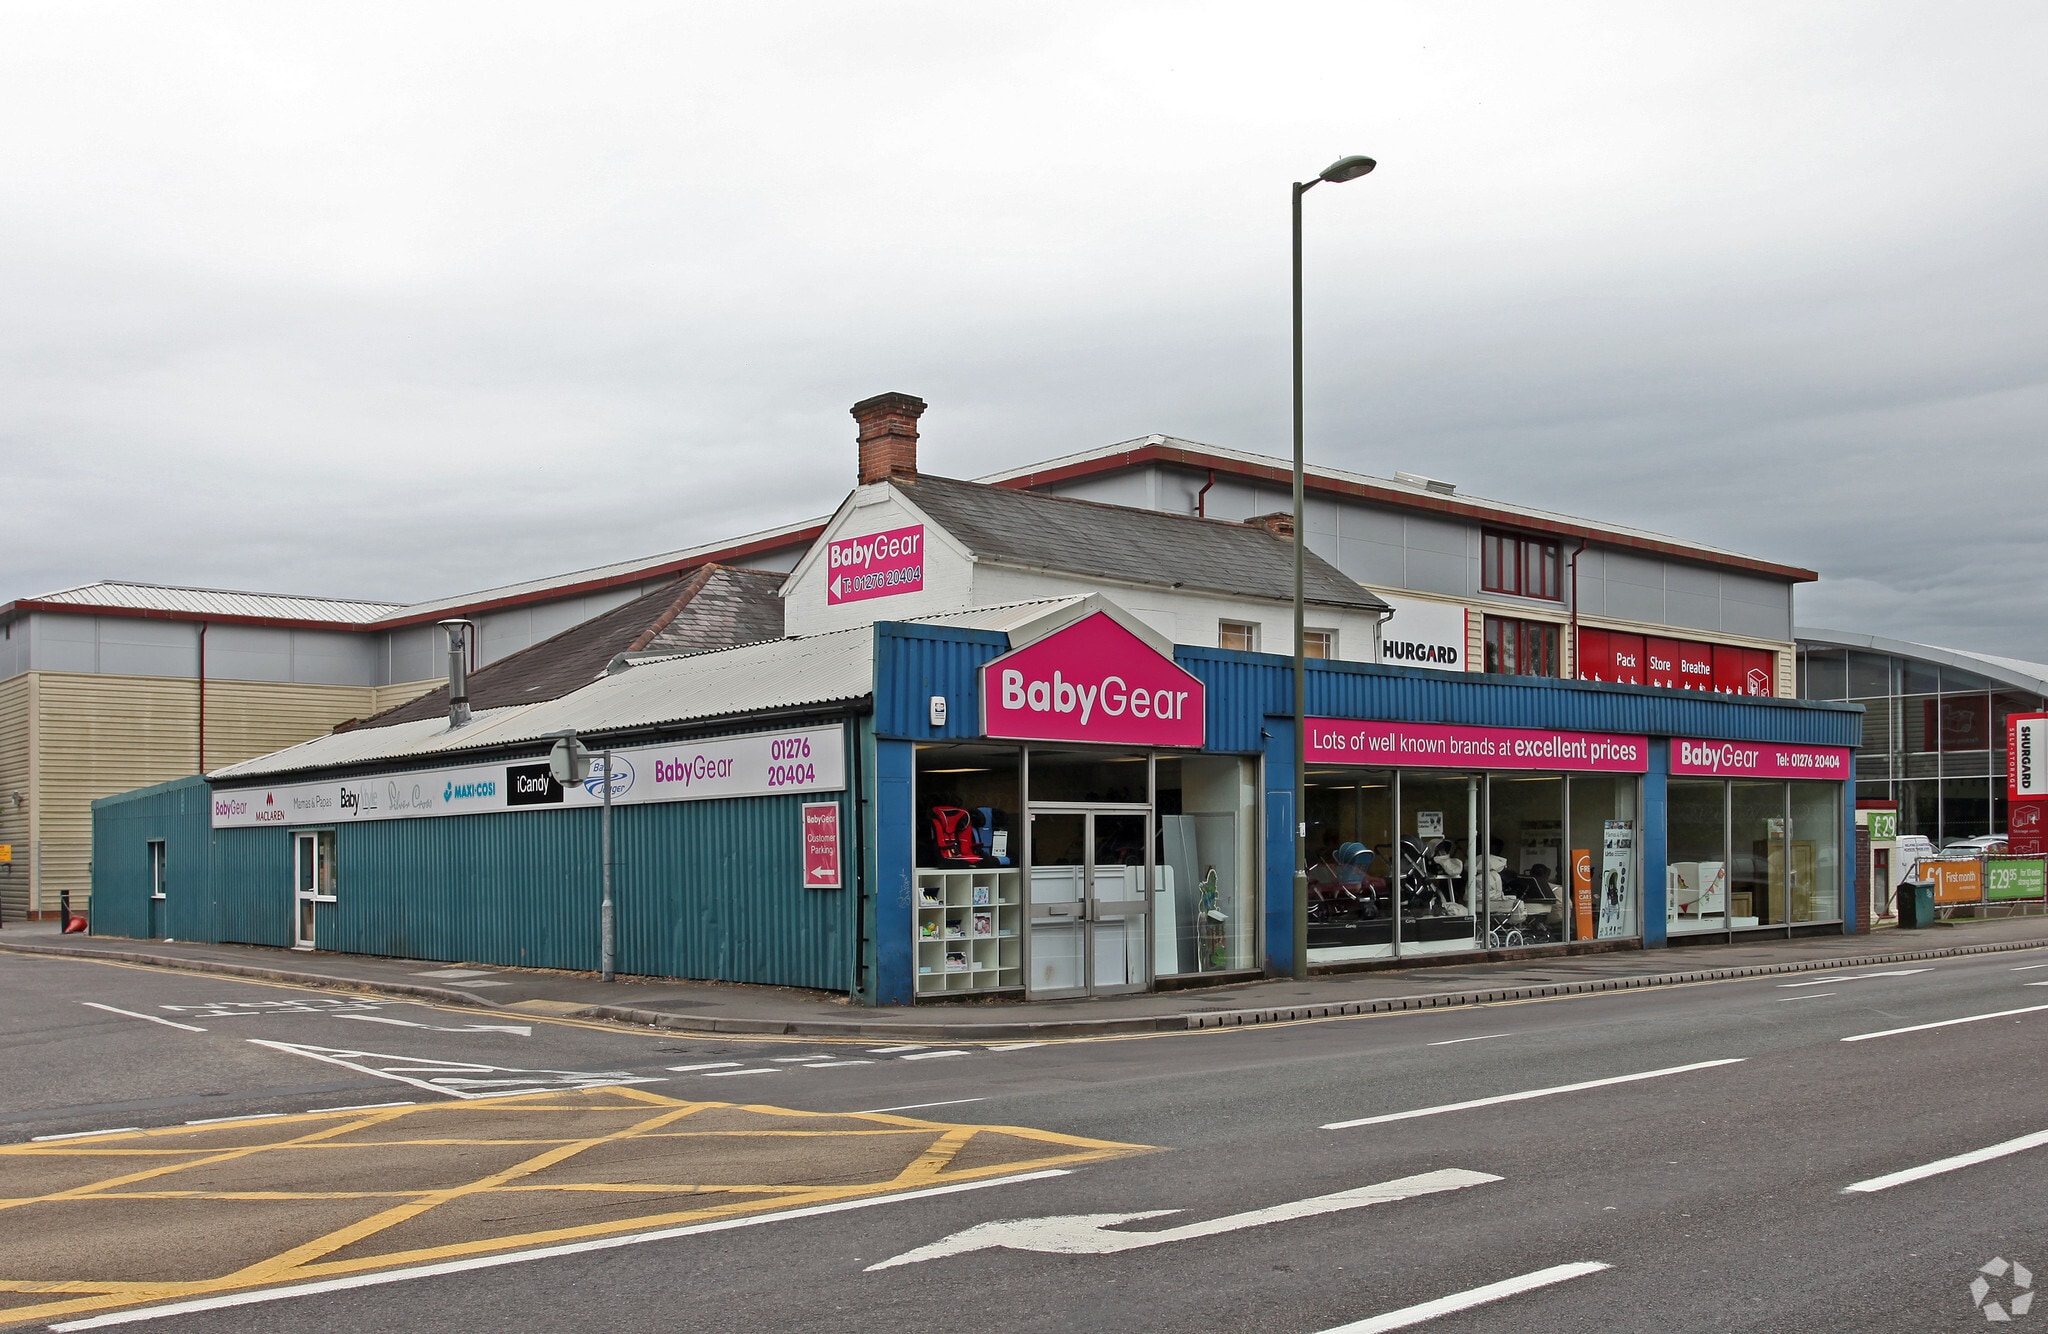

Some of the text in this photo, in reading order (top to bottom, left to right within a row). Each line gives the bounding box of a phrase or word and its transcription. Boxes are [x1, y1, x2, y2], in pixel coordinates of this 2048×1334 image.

[830, 534, 920, 569] BabyGear
[854, 574, 884, 592] 01276
[886, 565, 920, 587] 20404
[1616, 652, 1710, 675] Pack Store Breathe
[1002, 669, 1188, 726] BabyGear
[771, 737, 811, 760] 01276
[1313, 729, 1636, 764] Lots of well known brands at excellent prices
[1681, 742, 1840, 772] BabyGear Tel: 01276 20404
[2021, 726, 2031, 788] SHURGARD
[655, 755, 734, 787] BabyGear
[768, 763, 815, 786] 20404
[388, 780, 432, 810] Silver Cross
[517, 774, 550, 796] iCandy
[216, 800, 247, 819] BabyGear
[256, 810, 285, 822] MACLAREN
[806, 814, 835, 825] BabyGear
[808, 834, 836, 842] Customer
[810, 846, 834, 856] Parking
[1946, 872, 1958, 882] First
[1959, 871, 1975, 882] month
